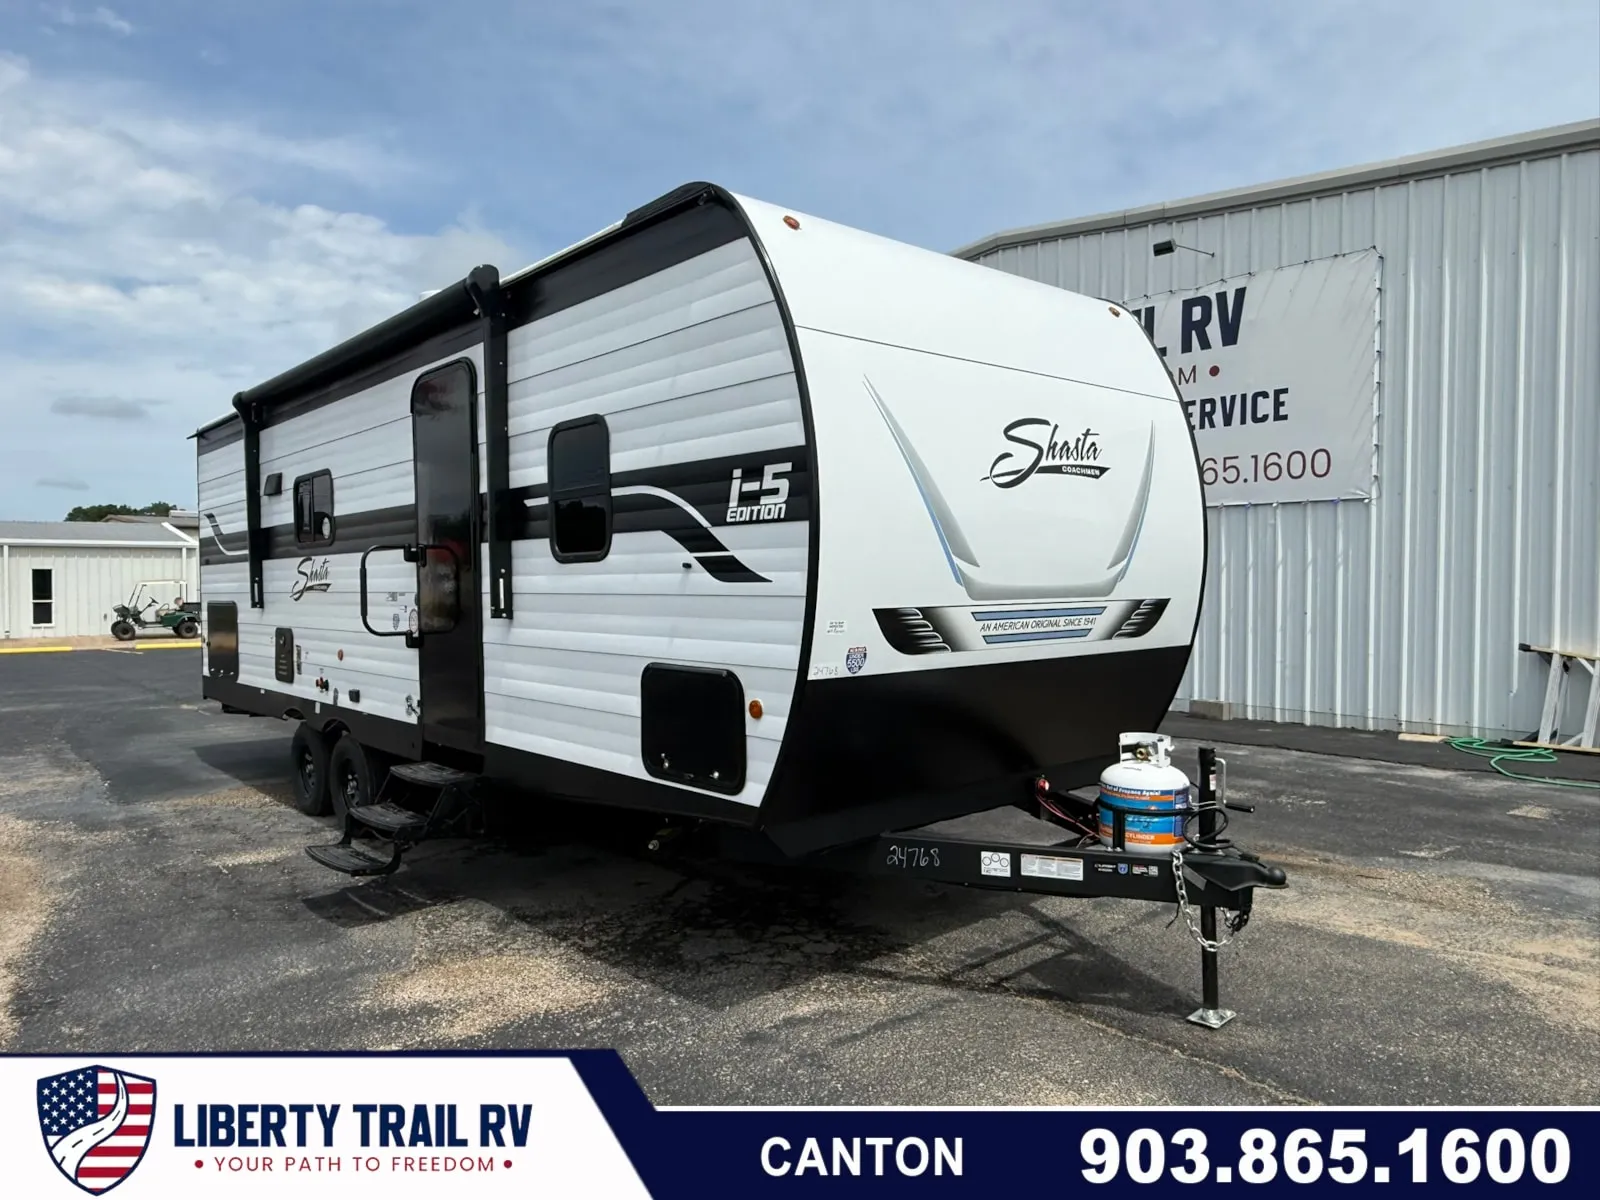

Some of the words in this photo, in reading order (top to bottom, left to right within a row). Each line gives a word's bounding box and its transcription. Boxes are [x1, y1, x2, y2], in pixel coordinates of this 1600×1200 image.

[1180, 286, 1247, 354] RV
[1172, 365, 1196, 385] M
[1184, 387, 1289, 431] ERVICE
[983, 417, 1103, 489] Shasta
[1061, 465, 1101, 476] COACHMEN
[1201, 448, 1332, 486] 65.1600
[726, 503, 787, 523] EDITION
[290, 556, 331, 602] Shasta
[979, 622, 991, 632] AN
[992, 620, 1030, 631] AMERICAN
[1030, 619, 1062, 630] ORIGINAL
[1062, 617, 1082, 628] SINCE
[1083, 616, 1097, 626] 1941
[847, 658, 865, 668] 5500
[1125, 832, 1156, 841] CYLINDER
[886, 845, 941, 868] 24768
